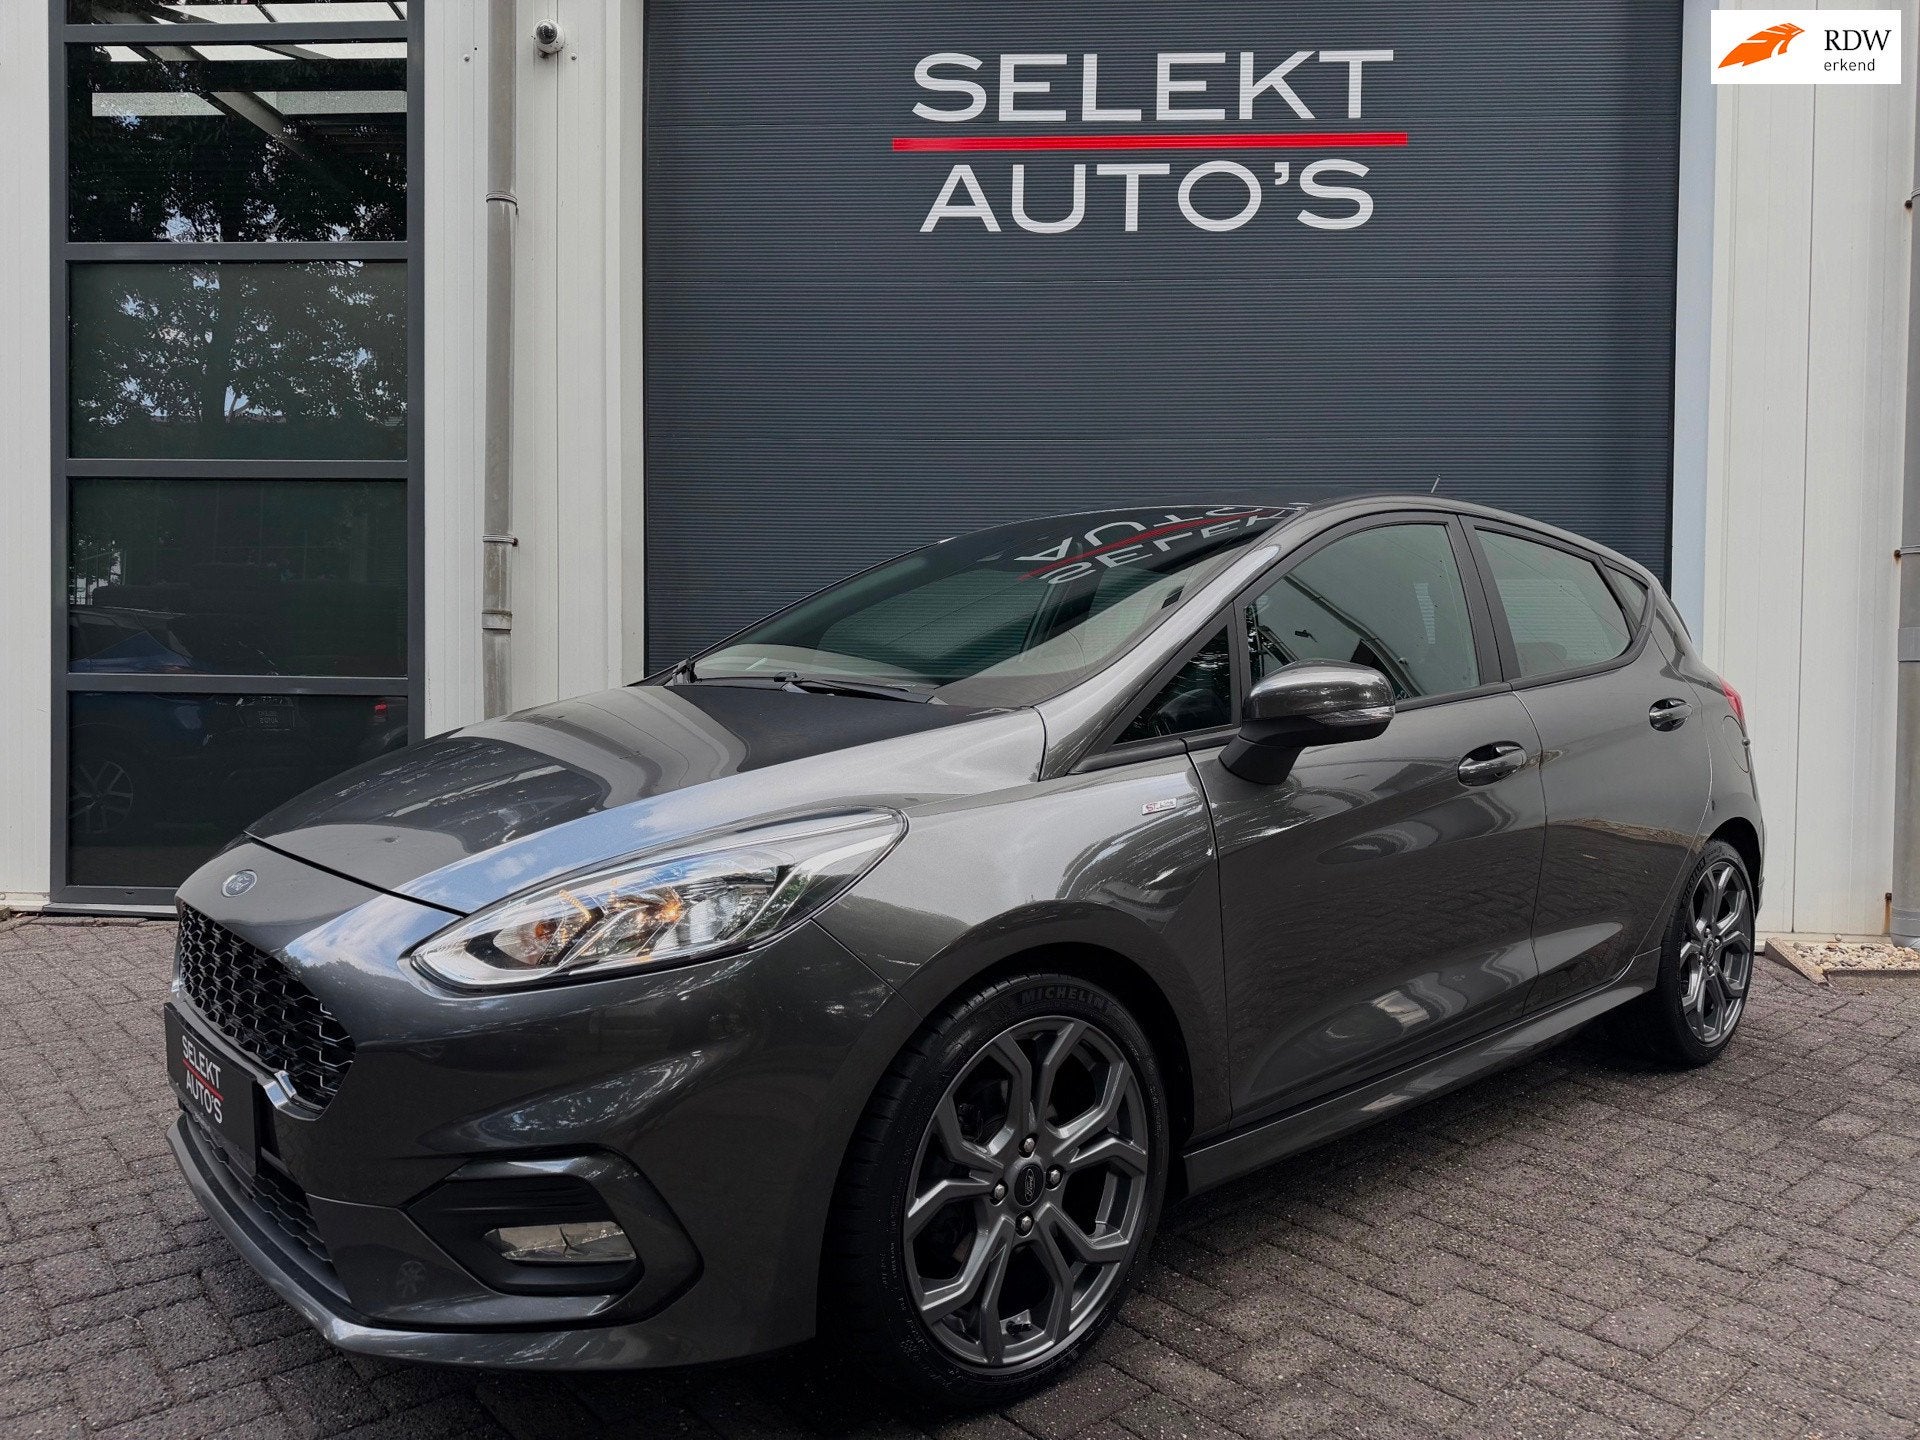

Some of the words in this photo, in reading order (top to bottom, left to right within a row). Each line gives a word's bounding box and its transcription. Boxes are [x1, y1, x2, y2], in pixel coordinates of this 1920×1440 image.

[911, 49, 1394, 122] SELEKT
[919, 158, 1374, 234] AUTO'S
[1021, 986, 1105, 1009] MICHELIN
[182, 1035, 221, 1089] SELEKT
[186, 1070, 223, 1124] AUTO'S
